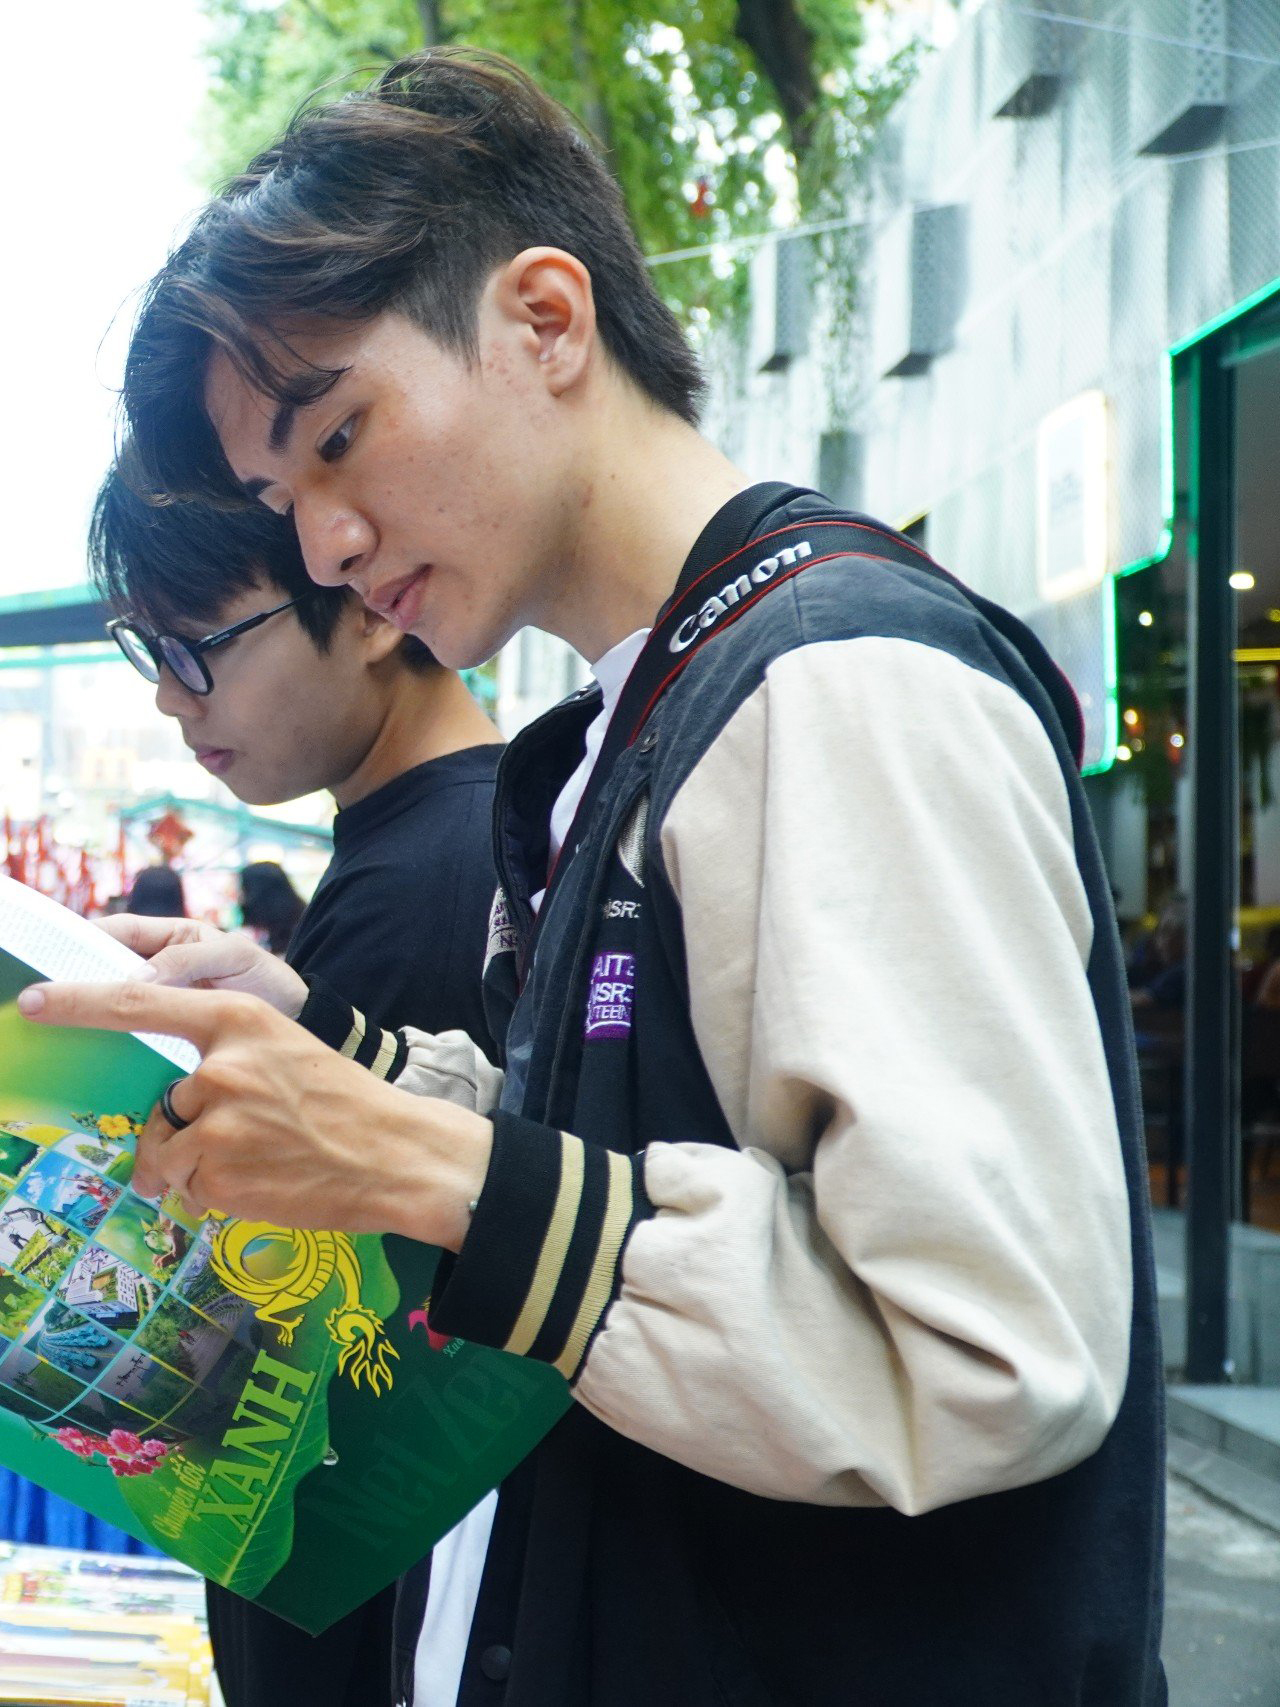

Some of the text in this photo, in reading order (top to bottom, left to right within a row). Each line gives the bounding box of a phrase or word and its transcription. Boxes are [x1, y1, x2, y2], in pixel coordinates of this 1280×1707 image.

[668, 540, 812, 653] Canon
[170, 1454, 206, 1490] đổi
[194, 1349, 317, 1534] XANH
